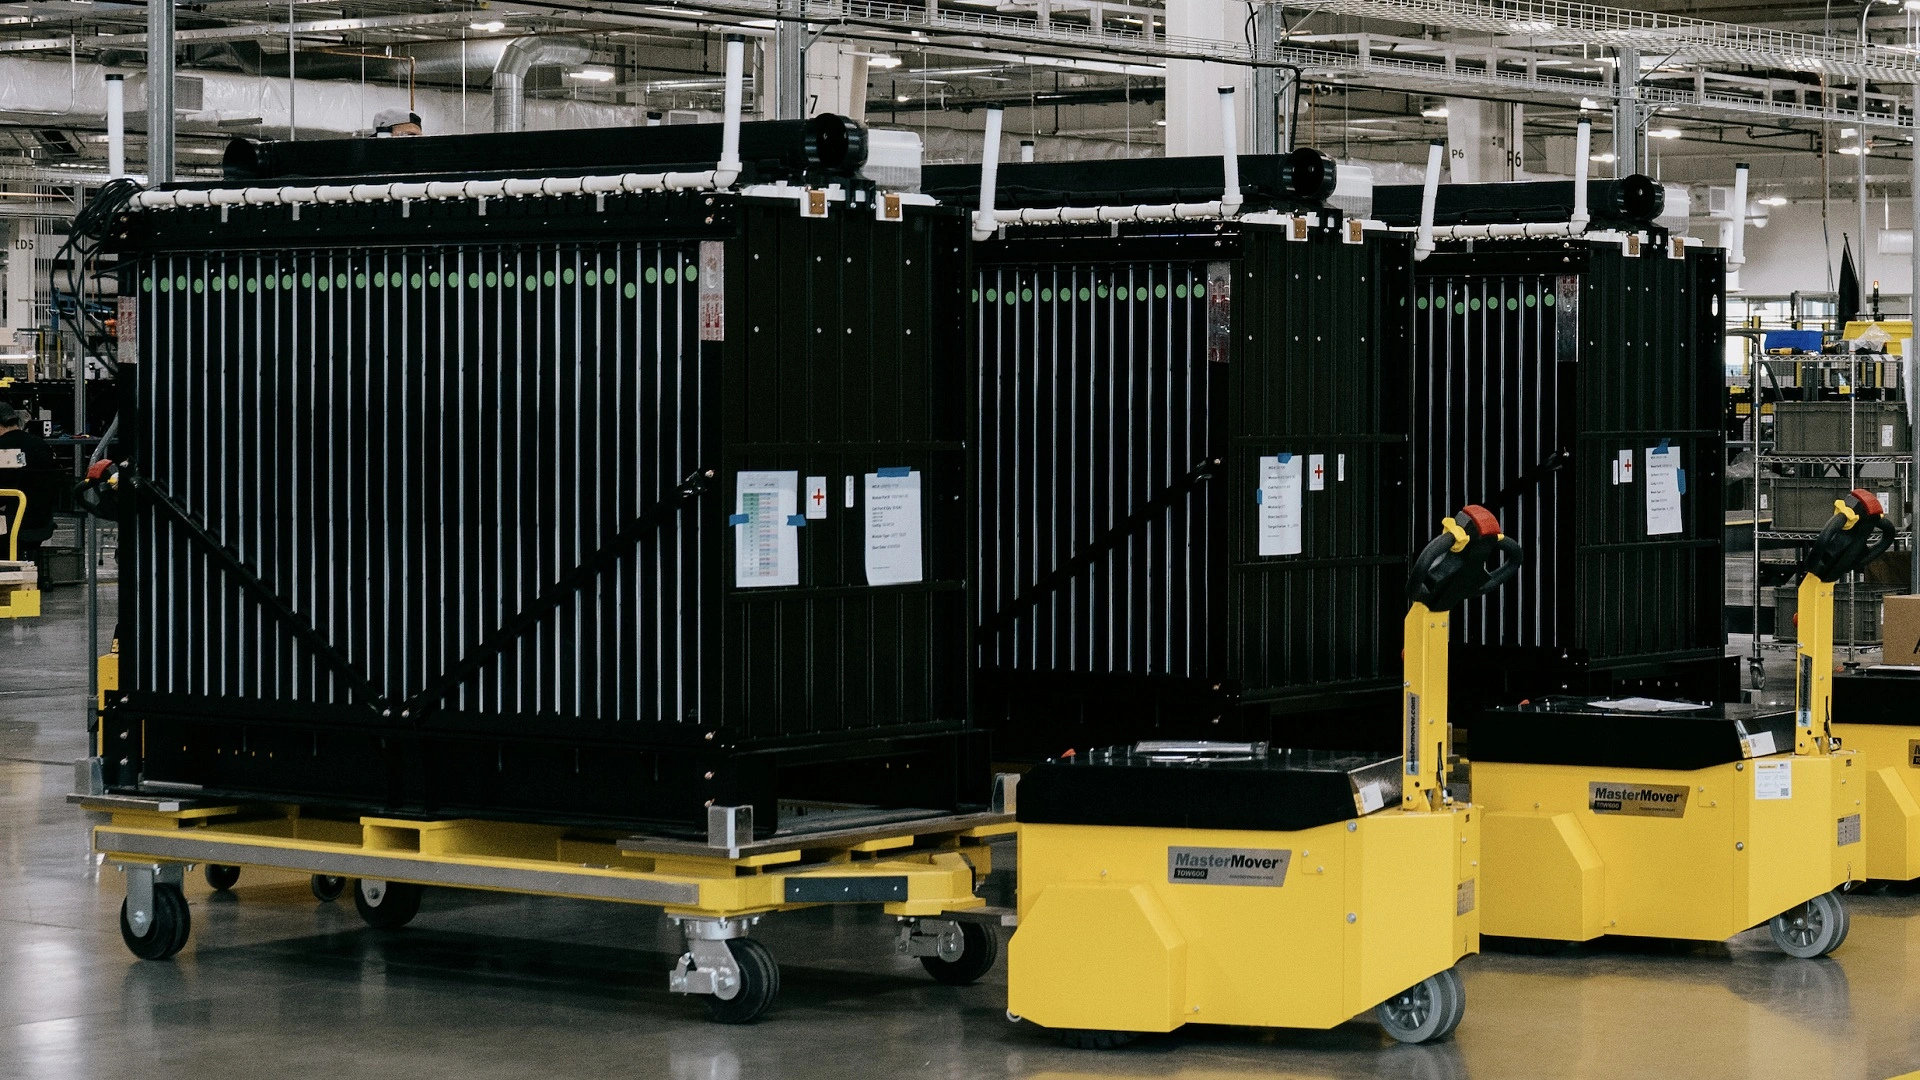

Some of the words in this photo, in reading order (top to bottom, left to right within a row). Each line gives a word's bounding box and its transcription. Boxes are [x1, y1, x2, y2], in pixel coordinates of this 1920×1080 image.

[1452, 149, 1464, 158] P6
[1595, 787, 1680, 802] MasterMover
[1175, 853, 1279, 869] MasterMover
[1176, 869, 1205, 878] TOW600
